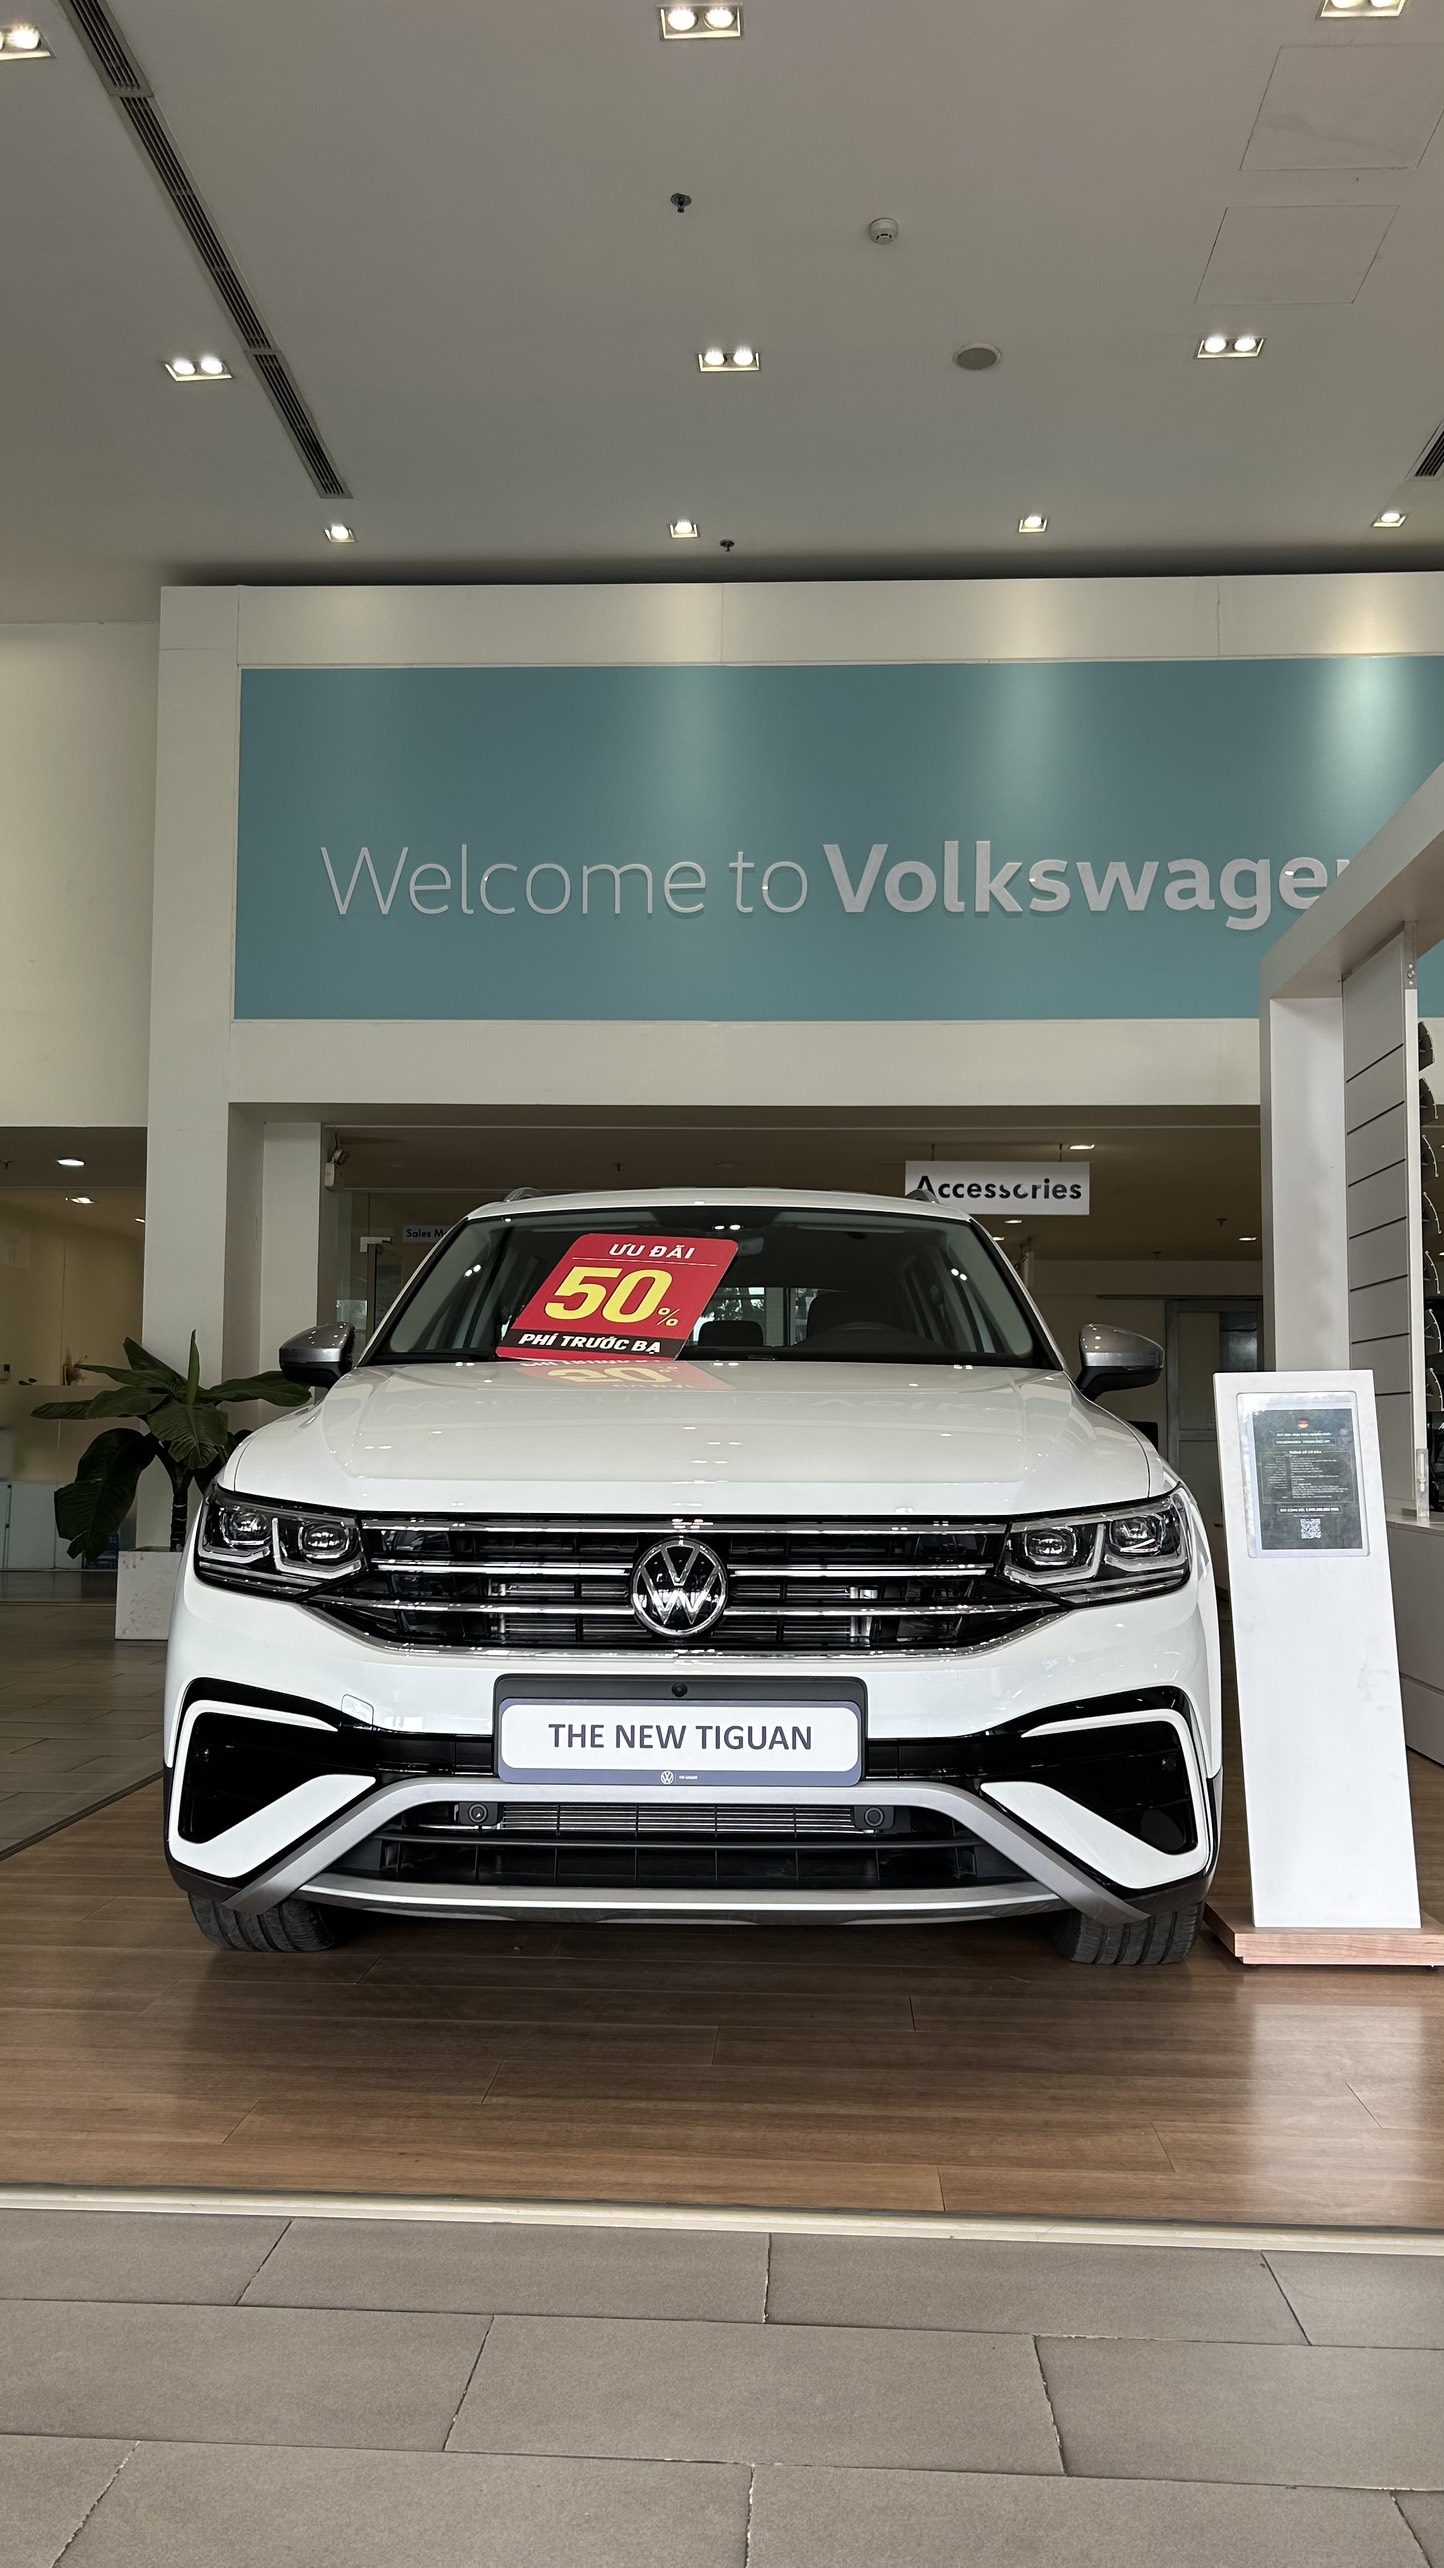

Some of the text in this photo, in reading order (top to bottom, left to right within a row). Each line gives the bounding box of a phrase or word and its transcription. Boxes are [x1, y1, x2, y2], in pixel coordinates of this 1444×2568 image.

[320, 840, 1350, 931] Welcome to Volkswage
[917, 1175, 1082, 1200] Accessories
[406, 1228, 431, 1238] Sales
[609, 1242, 696, 1260] ƯU ĐÃI
[518, 1331, 661, 1355] PHÍ TRƯỚC BẠ
[548, 1723, 812, 1751] THE NEW TIGUAN
